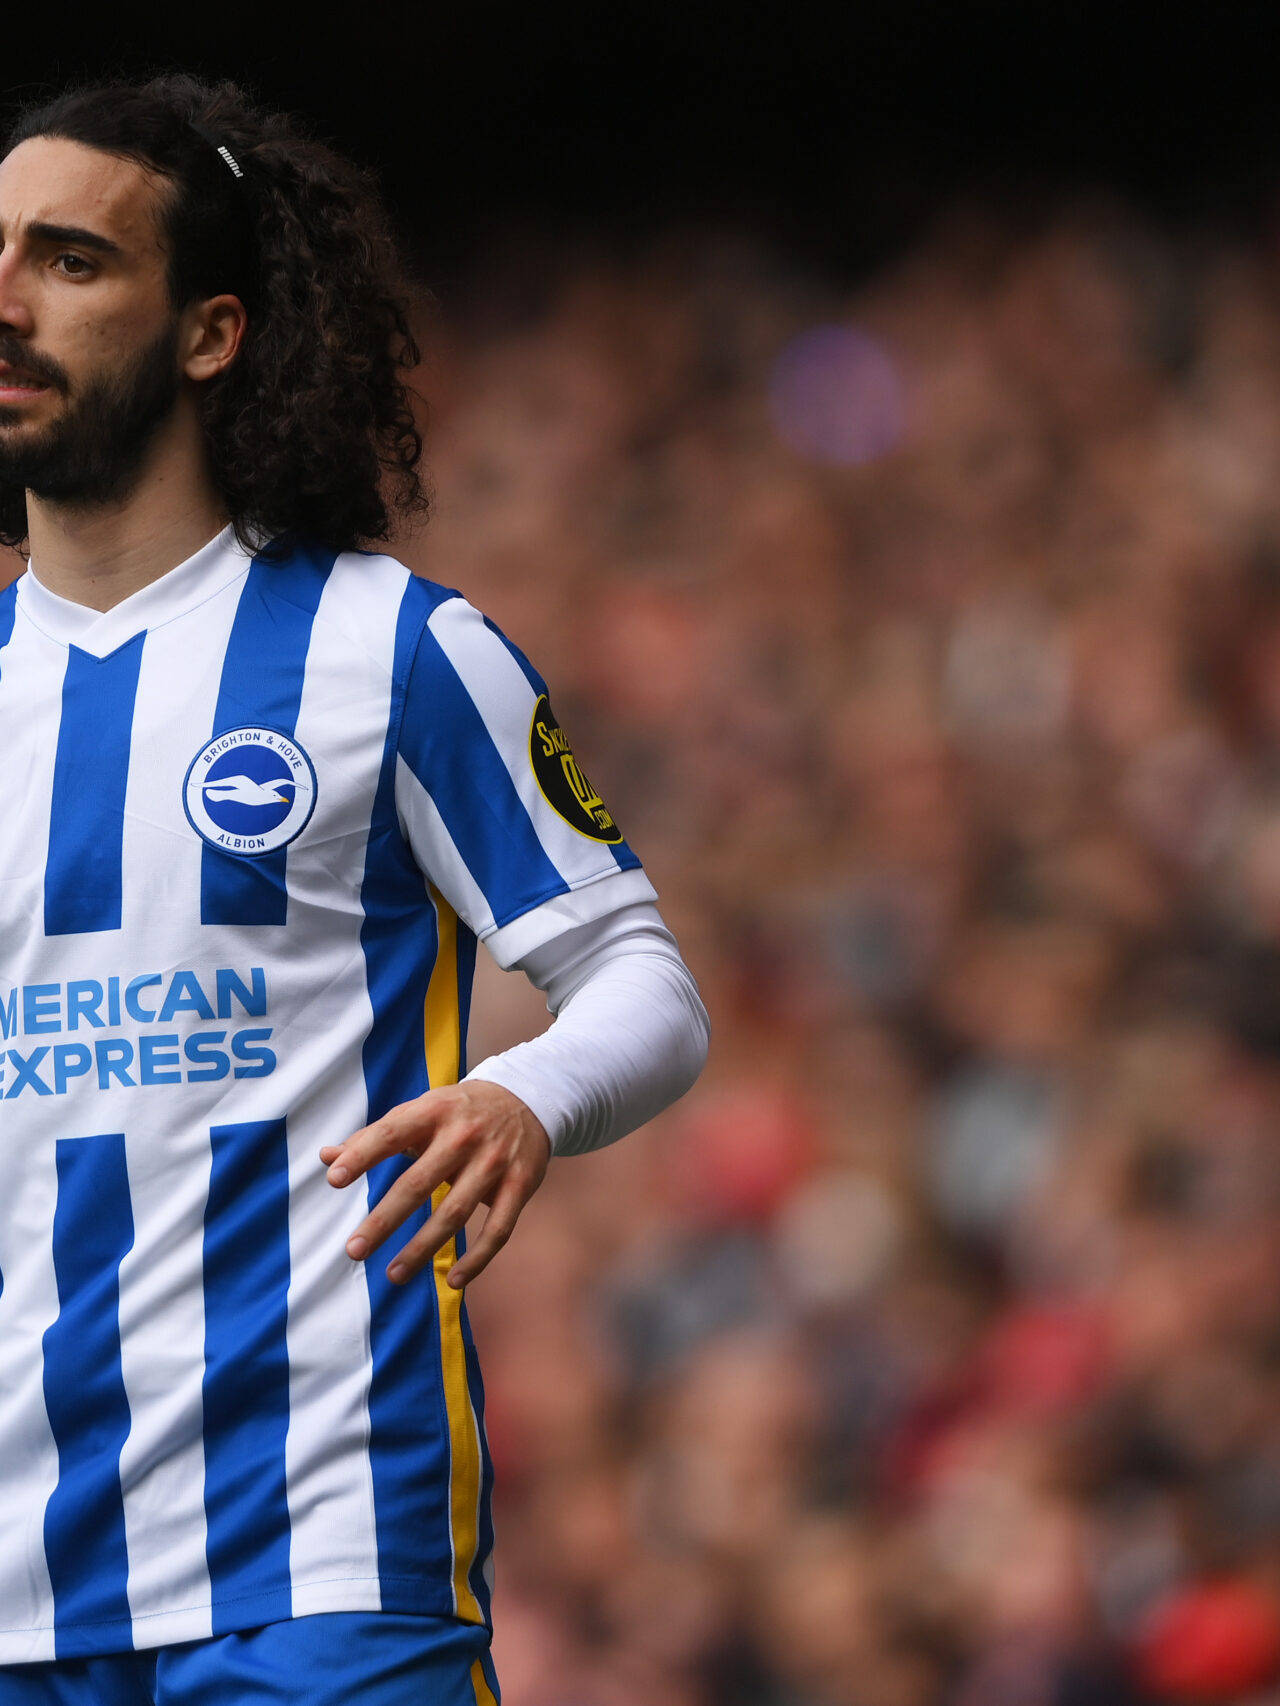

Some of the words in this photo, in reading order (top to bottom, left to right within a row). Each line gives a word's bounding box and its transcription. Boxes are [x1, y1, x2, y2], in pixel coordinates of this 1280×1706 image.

[203, 732, 261, 764] BRIGHTON
[266, 735, 274, 745] &
[277, 741, 302, 770] HOVE
[217, 833, 266, 849] ALBION
